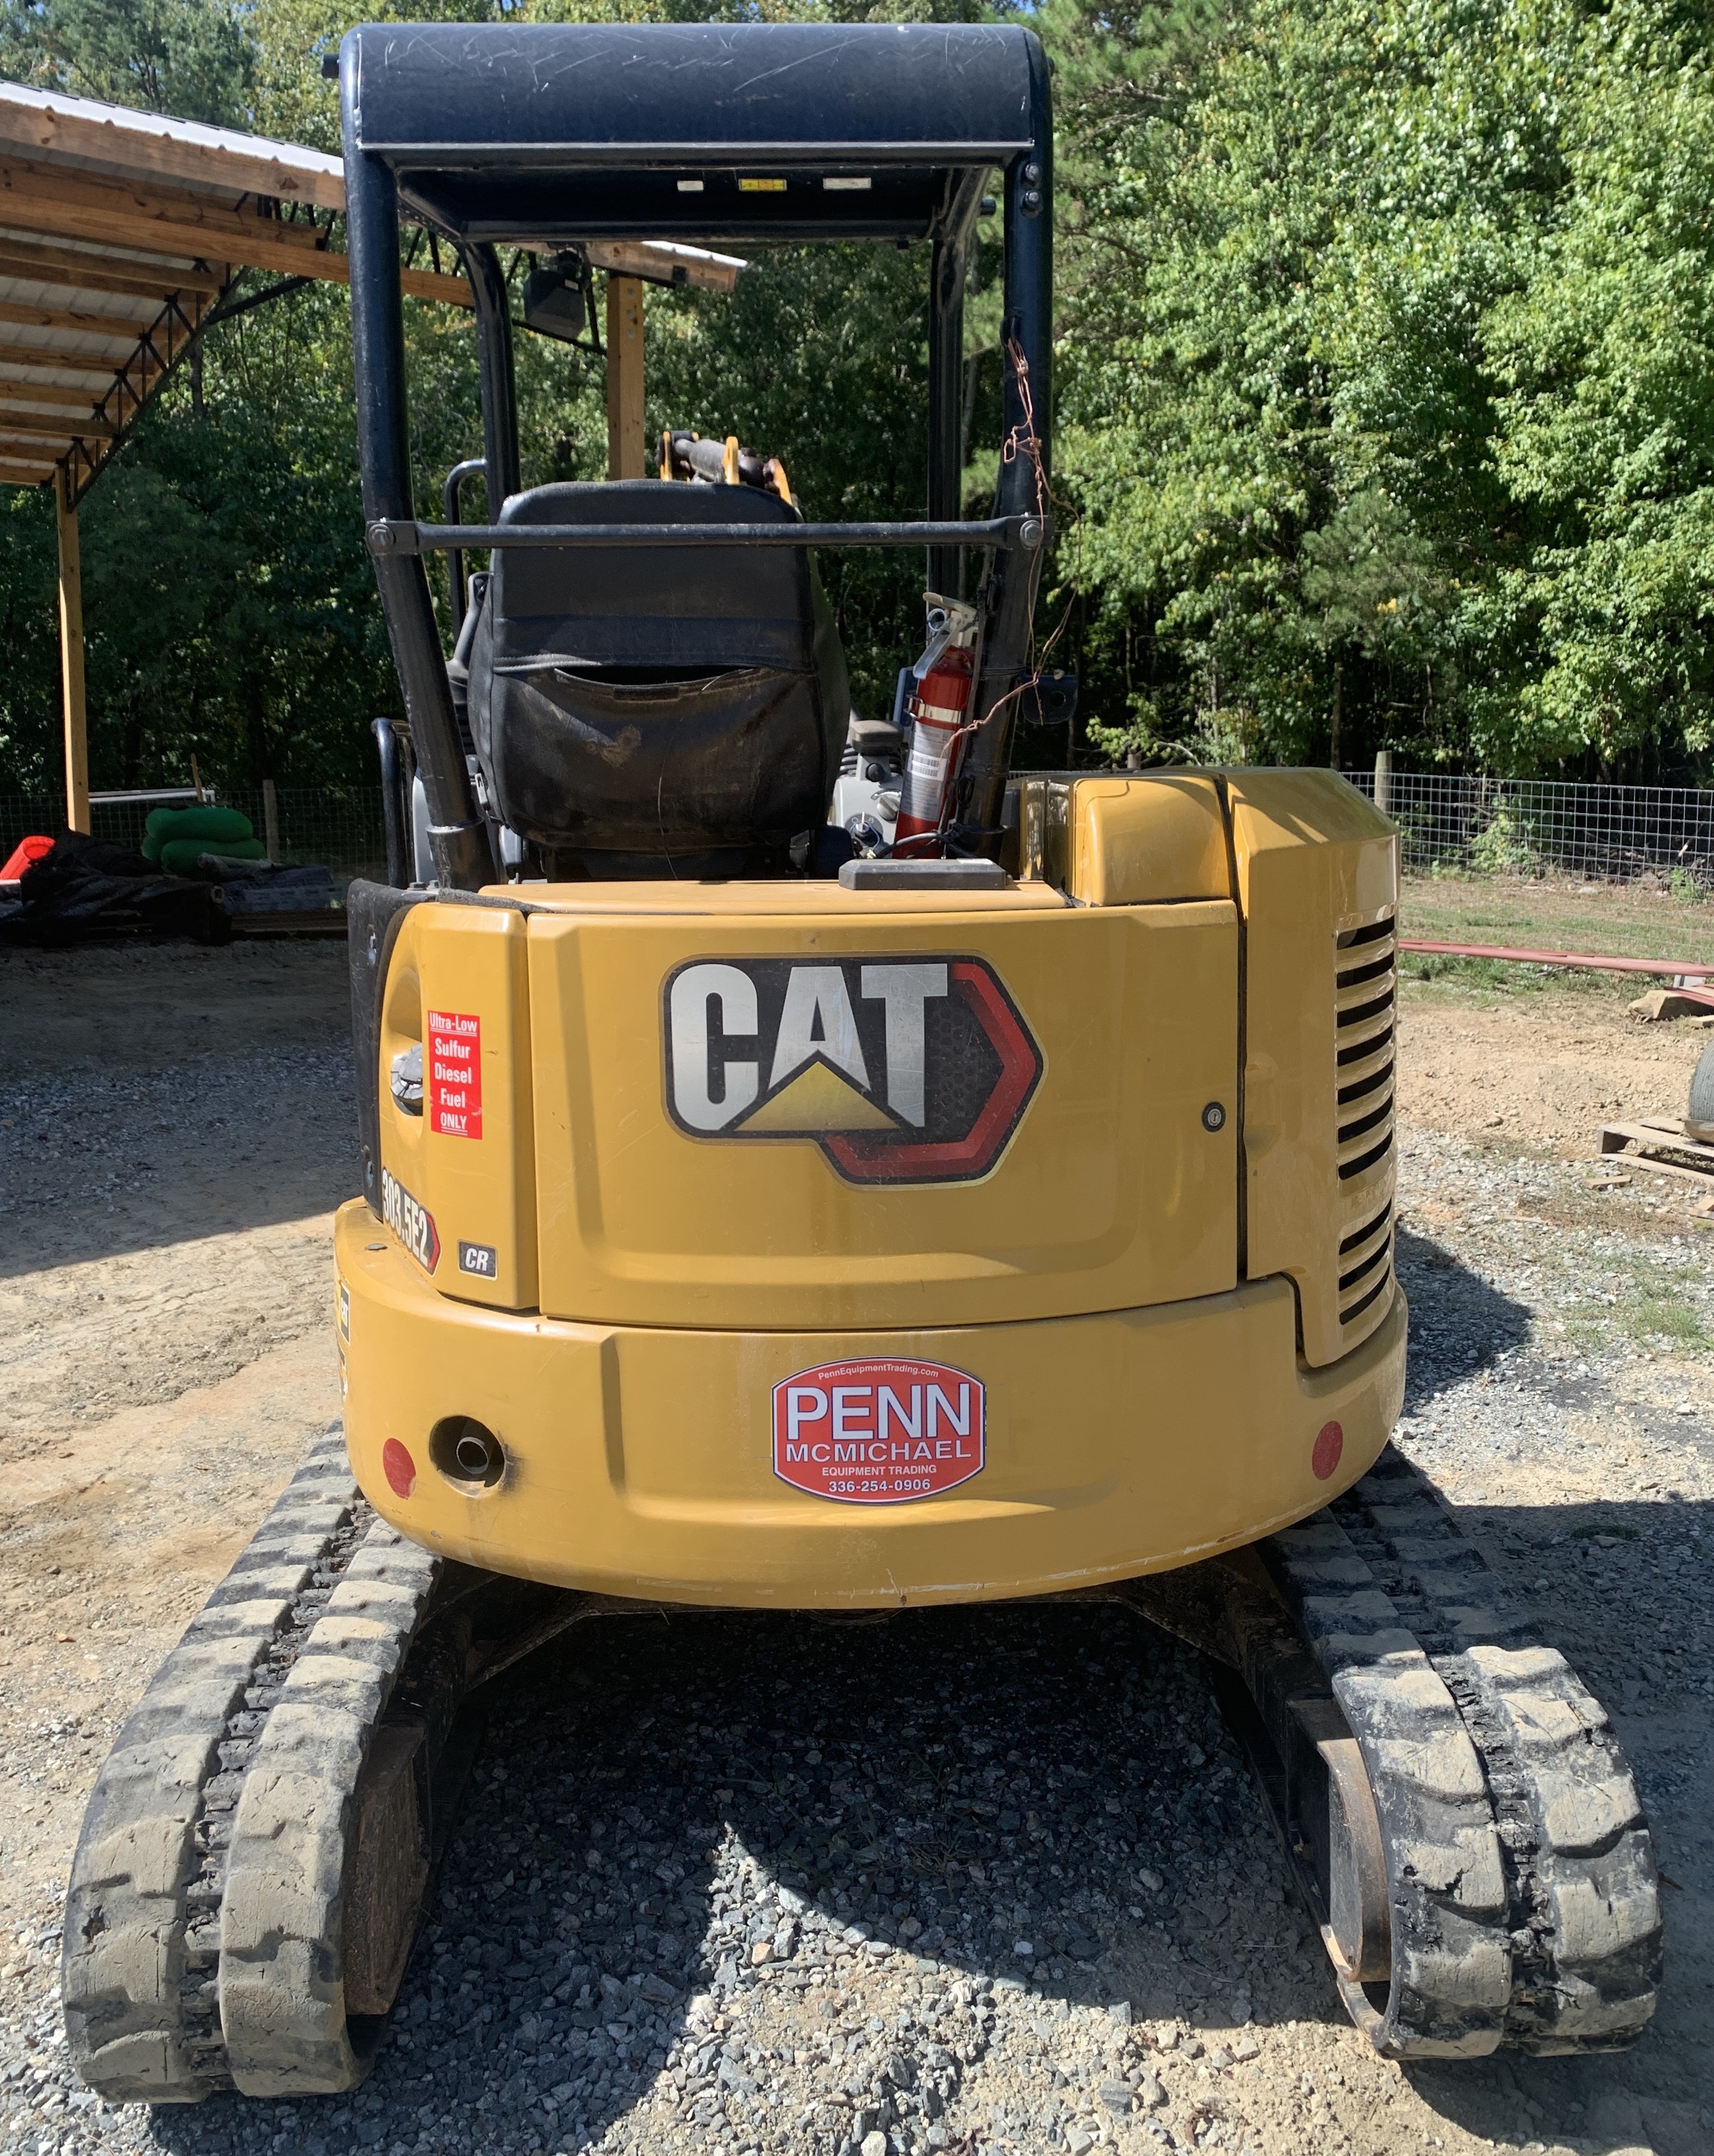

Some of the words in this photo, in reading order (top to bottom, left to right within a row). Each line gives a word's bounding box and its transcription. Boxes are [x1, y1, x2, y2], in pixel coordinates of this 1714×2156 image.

[429, 1012, 477, 1032] Ultra-Low
[434, 1037, 470, 1059] Sulfur
[670, 963, 948, 1131] CAT
[434, 1062, 472, 1084] Diesel
[440, 1088, 465, 1108] Fuel
[440, 1112, 467, 1130] ONLY
[382, 1169, 428, 1267] 303.5E2
[465, 1248, 489, 1271] CR
[818, 1363, 939, 1380] PennEquipmentTrading.com
[786, 1383, 971, 1441] PENN
[785, 1440, 971, 1463] MCMICHAEL
[822, 1466, 885, 1476] EQUIPMENT
[888, 1465, 937, 1475] TRADING
[828, 1478, 931, 1493] 336-254-0906
